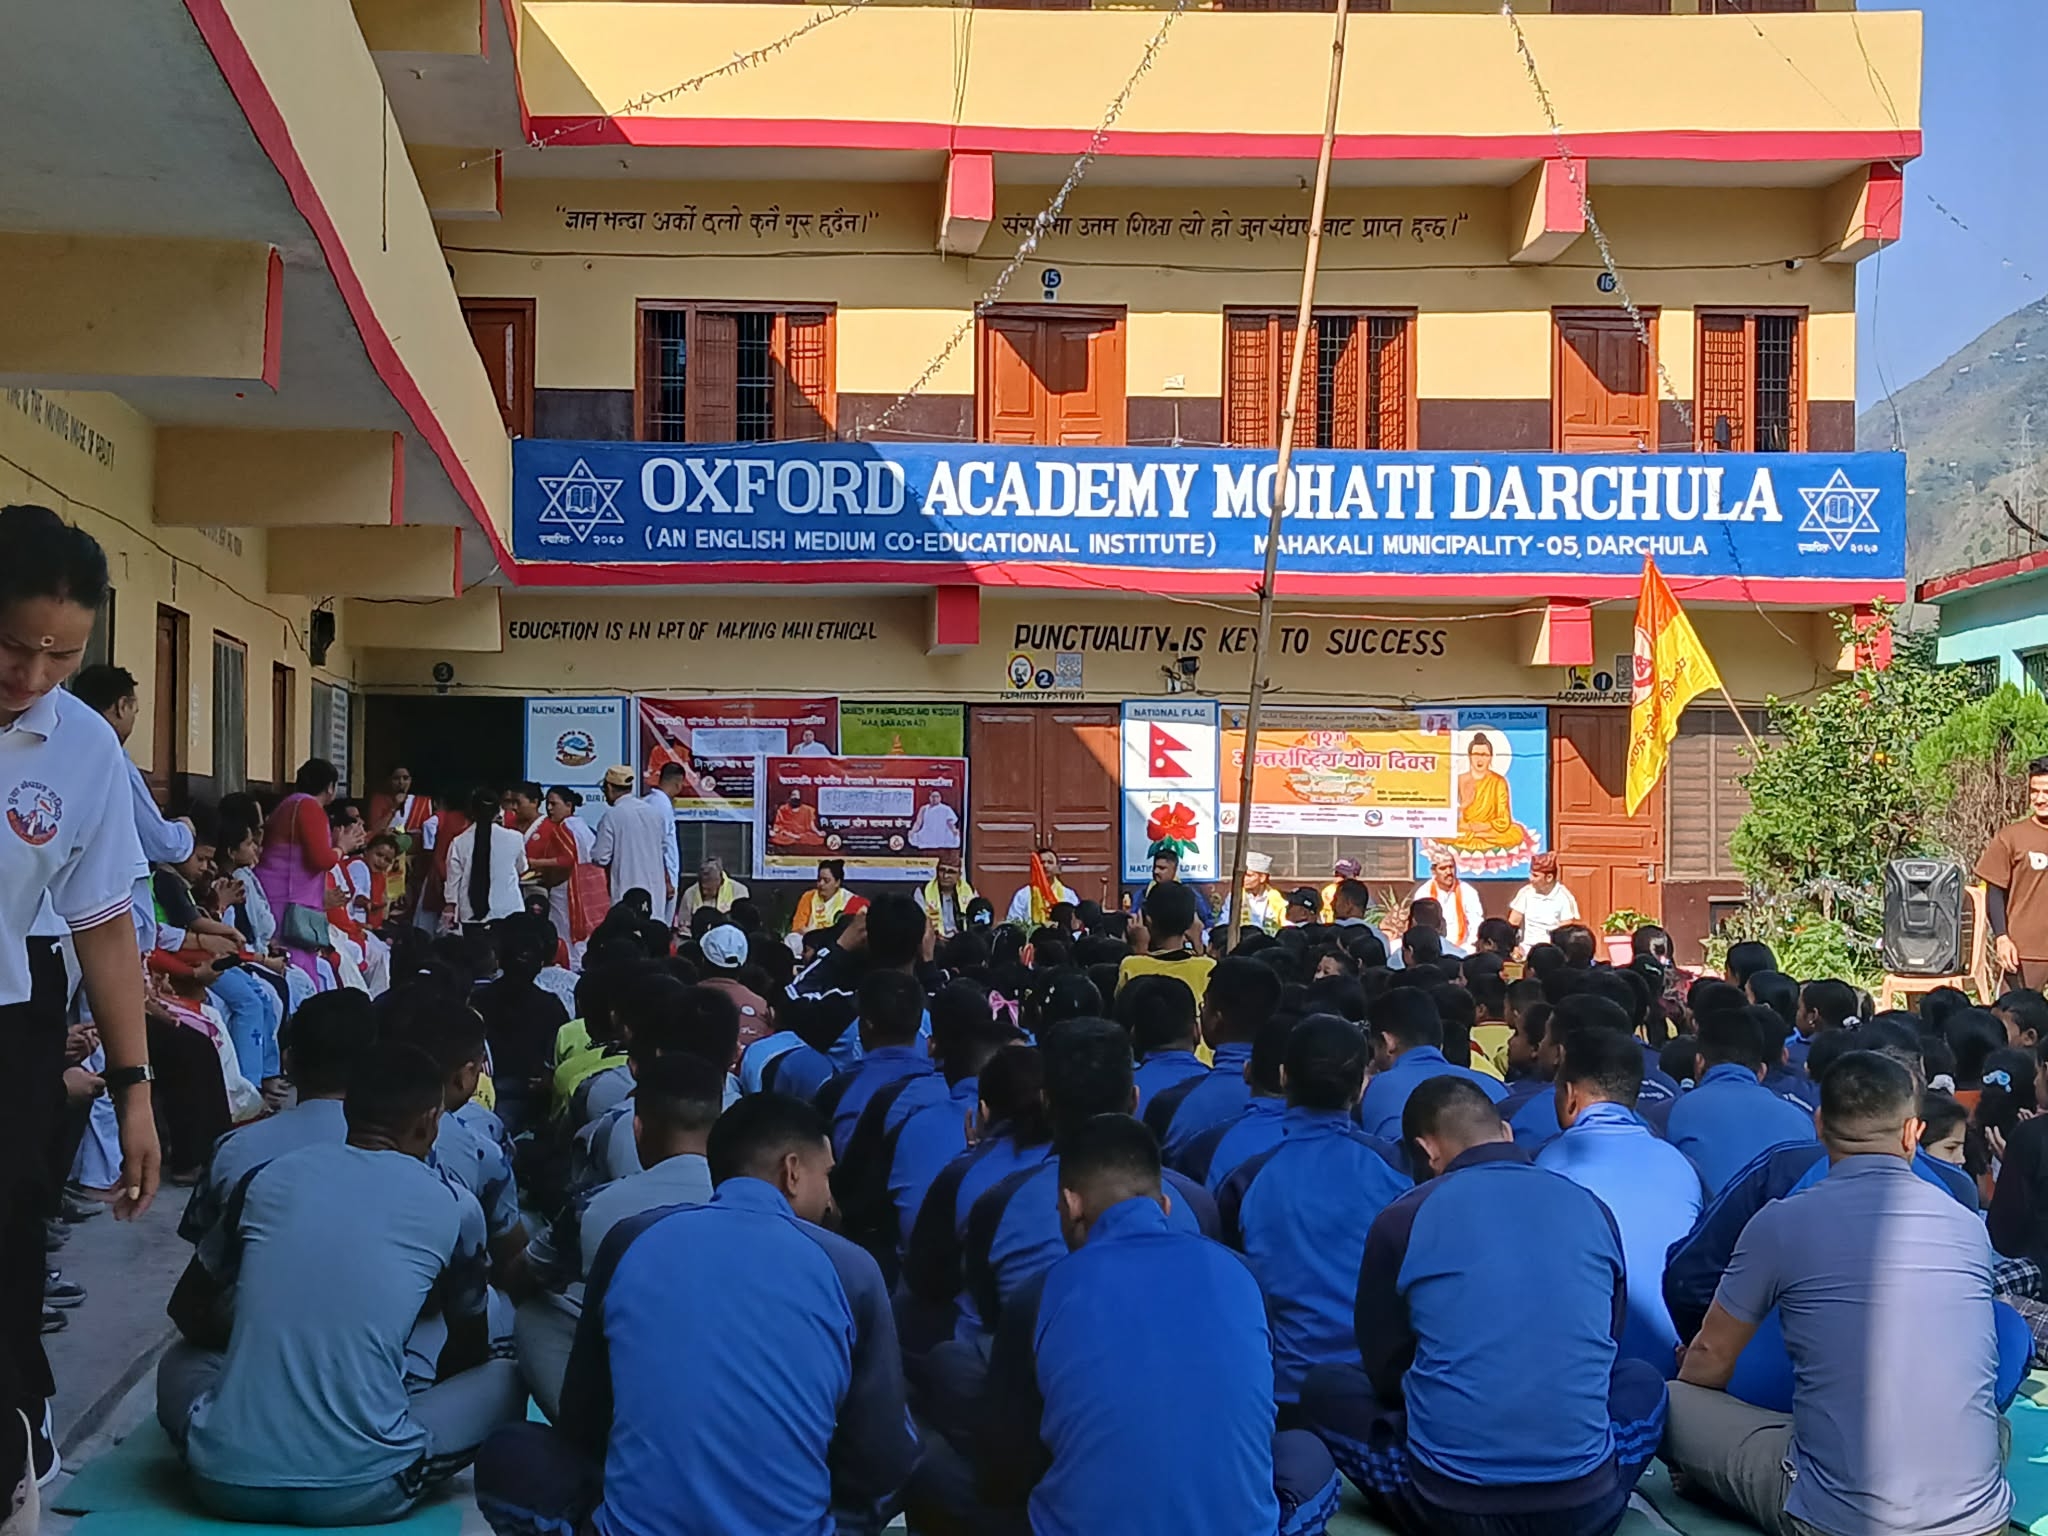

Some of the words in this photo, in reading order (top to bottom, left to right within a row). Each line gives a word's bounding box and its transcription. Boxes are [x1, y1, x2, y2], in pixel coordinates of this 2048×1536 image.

[1210, 209, 1234, 239] हो
[1045, 271, 1059, 286] 15
[1600, 275, 1614, 290] 16
[641, 457, 905, 515] OXFORD
[921, 460, 1199, 519] ACADEMY
[1212, 463, 1436, 521] MOHATI
[1450, 464, 1783, 522] DARCHULA
[644, 525, 687, 551] (AN
[699, 528, 787, 551] ENGLISH
[794, 530, 877, 552] MEDIUM
[884, 531, 1079, 555] CO-EDUCATIONAL
[1089, 532, 1217, 559] INSTITUTE)
[1253, 534, 1375, 556] MAHAKALI
[1382, 534, 1532, 557] MUNICIPALITY
[1586, 534, 1709, 557] DARCHULA
[605, 620, 624, 641] IS
[1014, 623, 1172, 652] PUNCTUALITY
[1182, 626, 1207, 652] IS
[1280, 627, 1310, 654] TO
[1325, 627, 1448, 657] SUCCESS
[1038, 671, 1051, 686] 2
[531, 705, 575, 715] NATIONAL
[577, 705, 615, 715] EMBLEM
[1133, 708, 1179, 718] NATIONAL
[1182, 708, 1206, 717] FLAG
[1343, 750, 1381, 770] योग
[1388, 750, 1437, 771] दिवस
[585, 793, 606, 803] BIR
